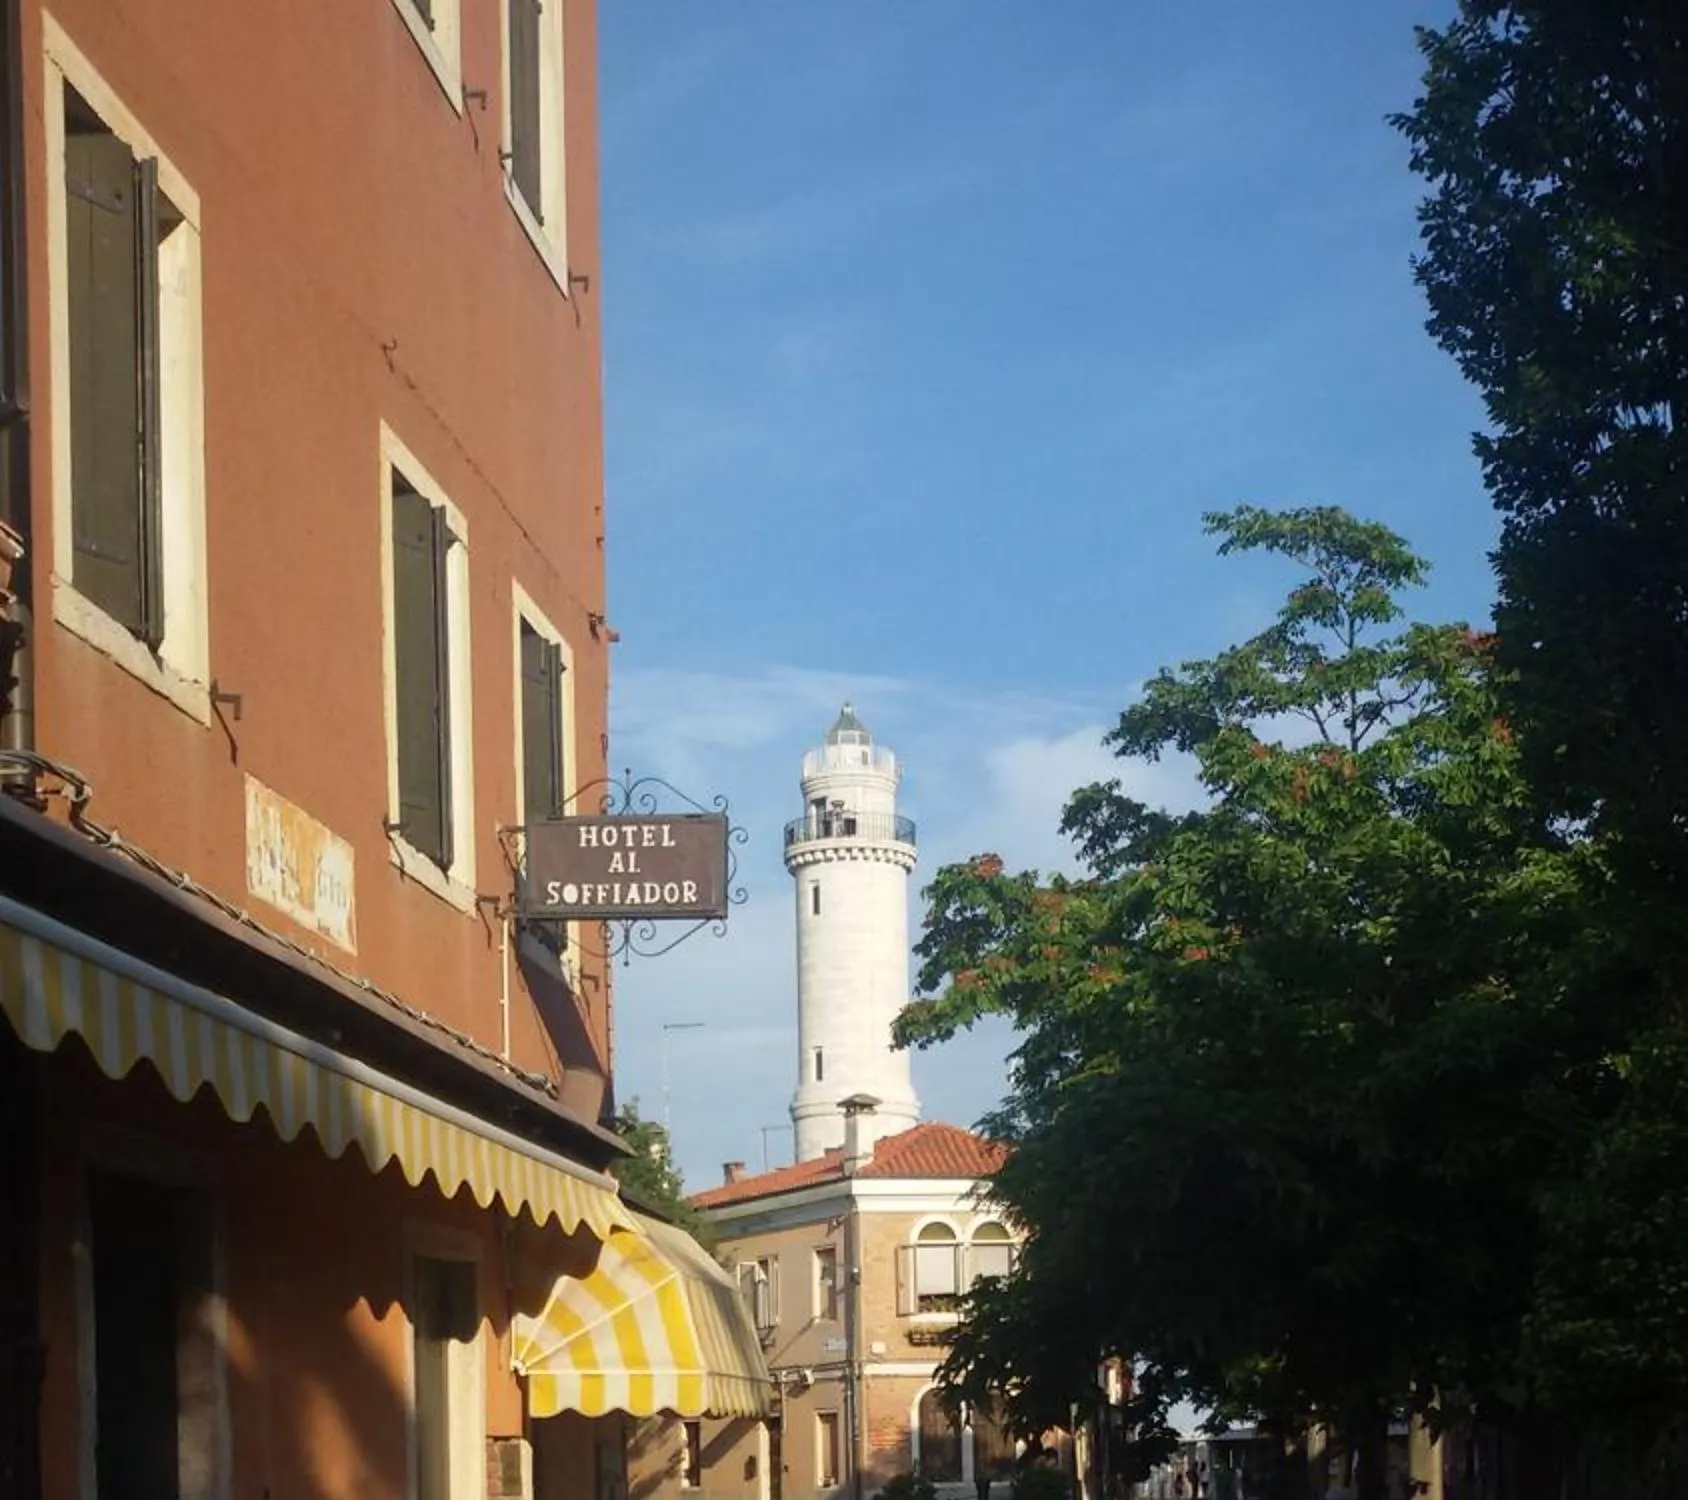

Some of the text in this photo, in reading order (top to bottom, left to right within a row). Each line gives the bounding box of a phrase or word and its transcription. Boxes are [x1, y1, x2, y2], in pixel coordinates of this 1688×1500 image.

[578, 824, 676, 847] HOTEL
[608, 851, 641, 873] AL
[546, 880, 698, 905] SOFFIADOR
